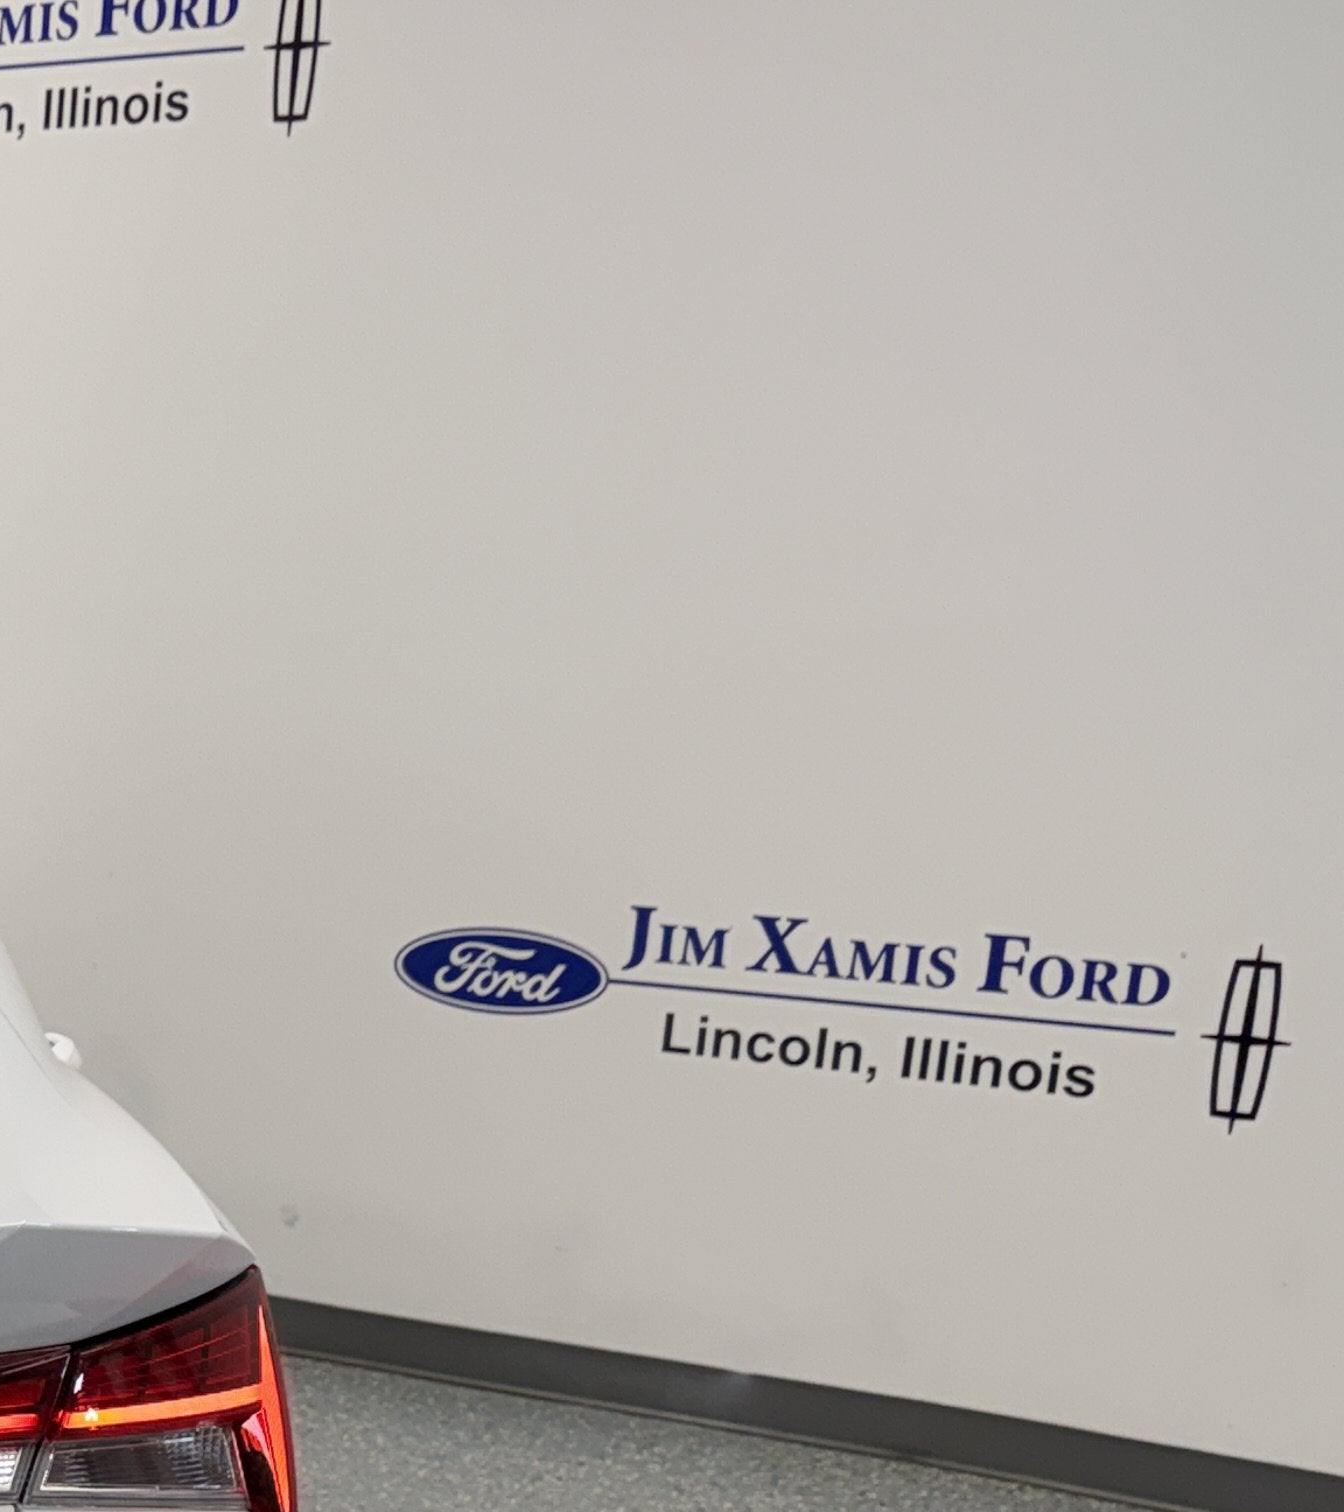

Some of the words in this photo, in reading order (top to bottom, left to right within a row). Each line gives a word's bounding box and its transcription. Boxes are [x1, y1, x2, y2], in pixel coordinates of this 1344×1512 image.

[96, 0, 238, 36] FORD
[44, 81, 188, 129] Illinois
[434, 940, 561, 1003] Ford
[622, 906, 728, 970] JIM
[747, 916, 956, 988] XAMIS
[978, 934, 1170, 1005] FORD
[662, 1013, 876, 1082] Lincoln,
[902, 1037, 1094, 1097] Illinois
